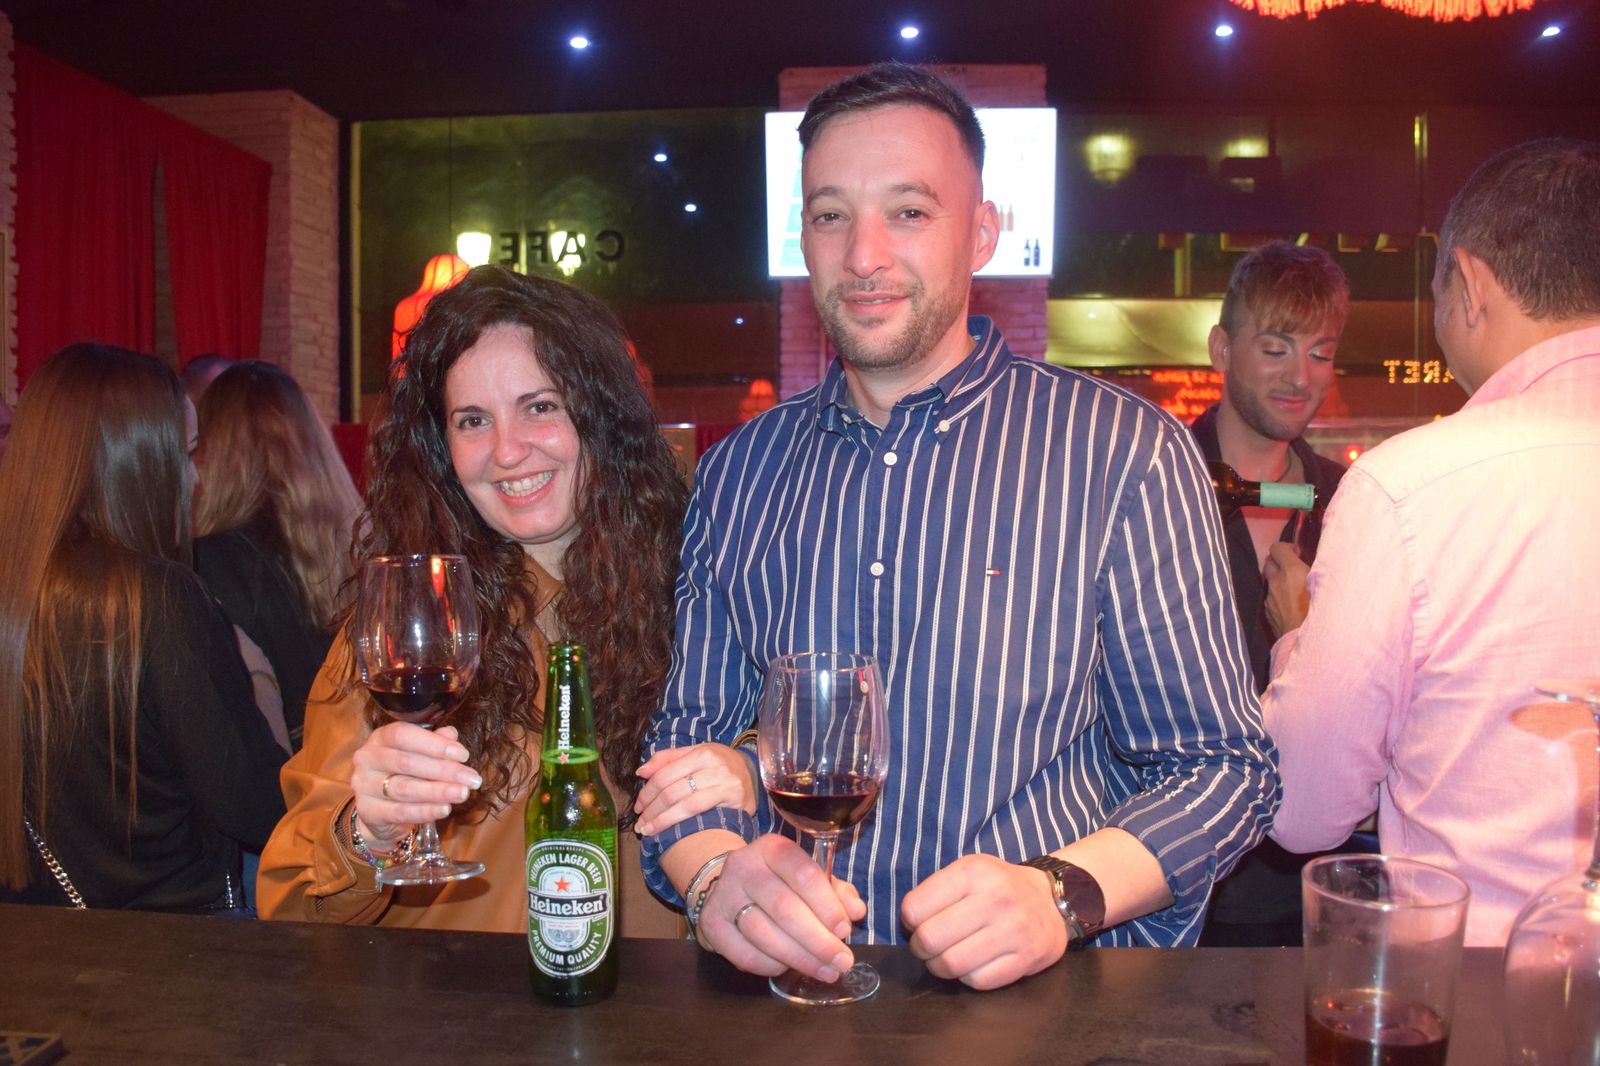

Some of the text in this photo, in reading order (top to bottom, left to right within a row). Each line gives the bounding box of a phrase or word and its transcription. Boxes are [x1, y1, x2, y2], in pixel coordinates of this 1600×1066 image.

[558, 684, 571, 750] Heineken
[530, 853, 557, 882] HEINEKEN
[559, 854, 588, 869] LAGER
[586, 862, 602, 884] BEER
[530, 894, 604, 915] Heineken
[532, 929, 565, 965] PREMIUM
[567, 932, 602, 965] QUALITY
